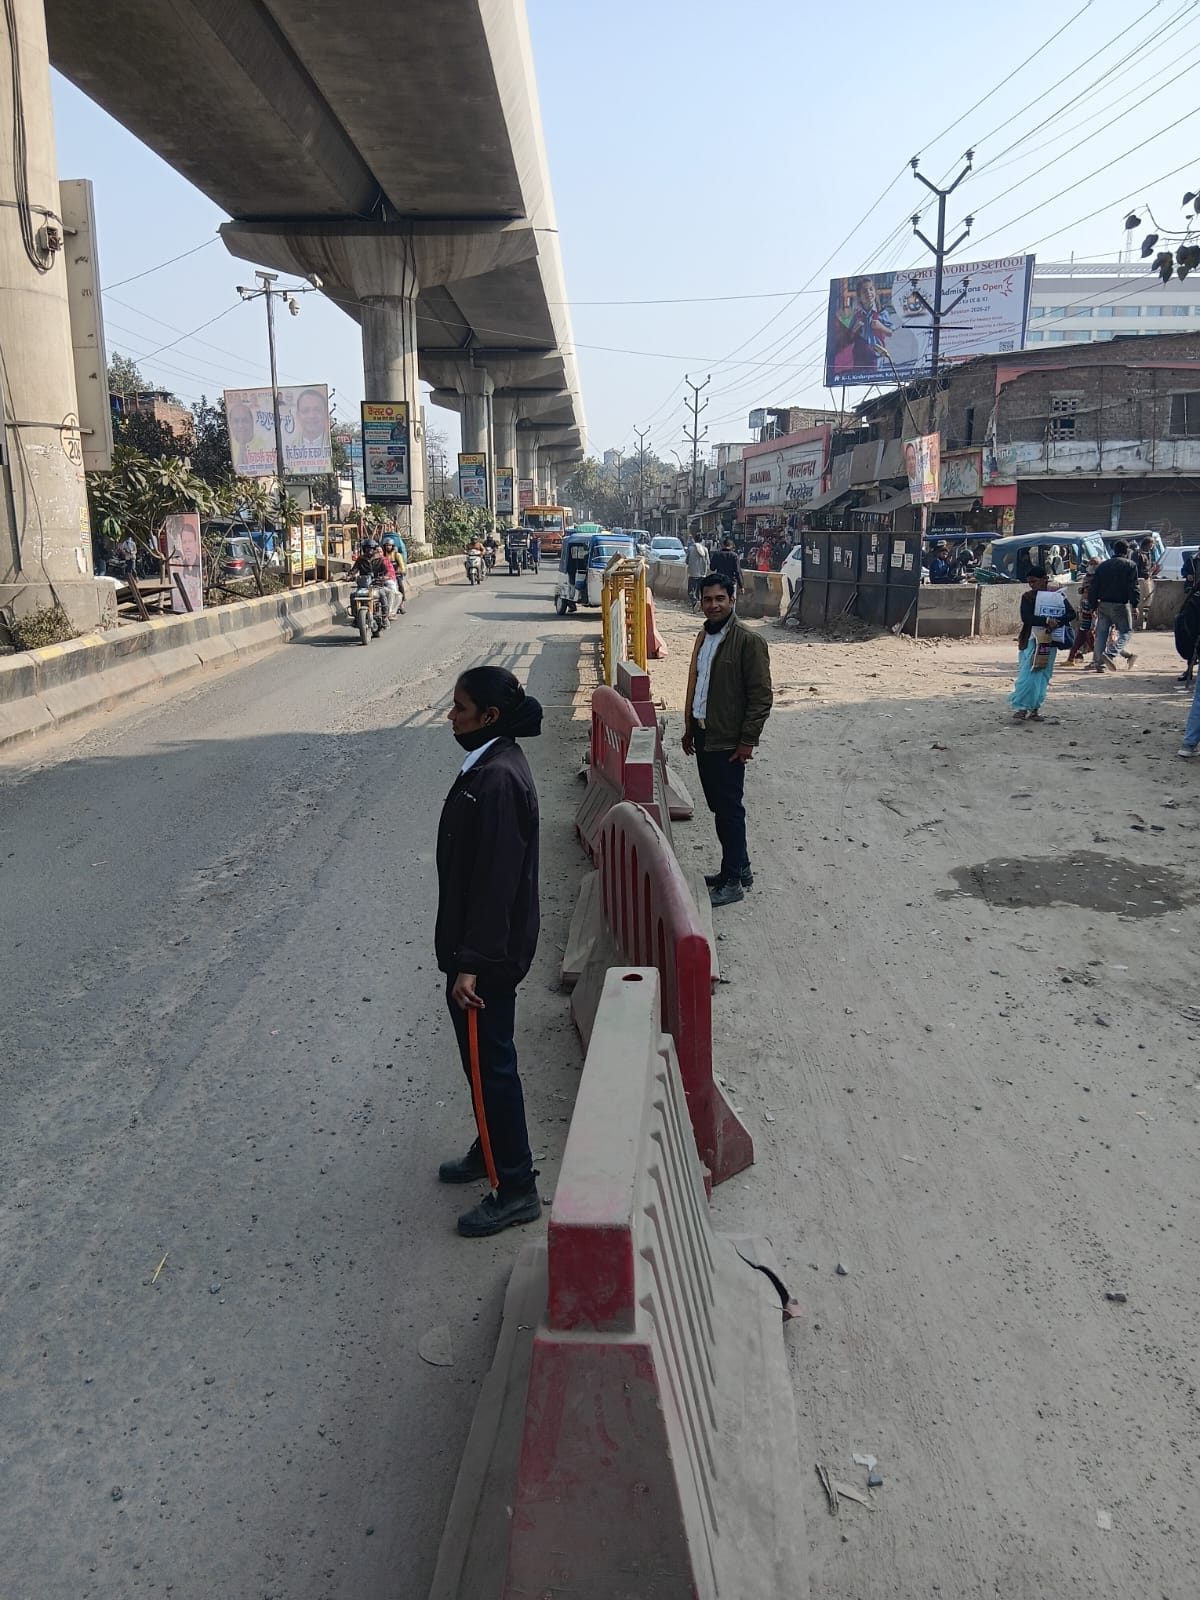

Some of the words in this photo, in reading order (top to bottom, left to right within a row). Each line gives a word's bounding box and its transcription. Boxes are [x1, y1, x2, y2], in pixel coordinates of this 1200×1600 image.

[896, 269, 939, 281] ESCORTS
[941, 261, 979, 275] WORLD
[981, 257, 1025, 270] SCHOOL
[941, 286, 981, 296] Admissons
[982, 282, 1003, 293] Open
